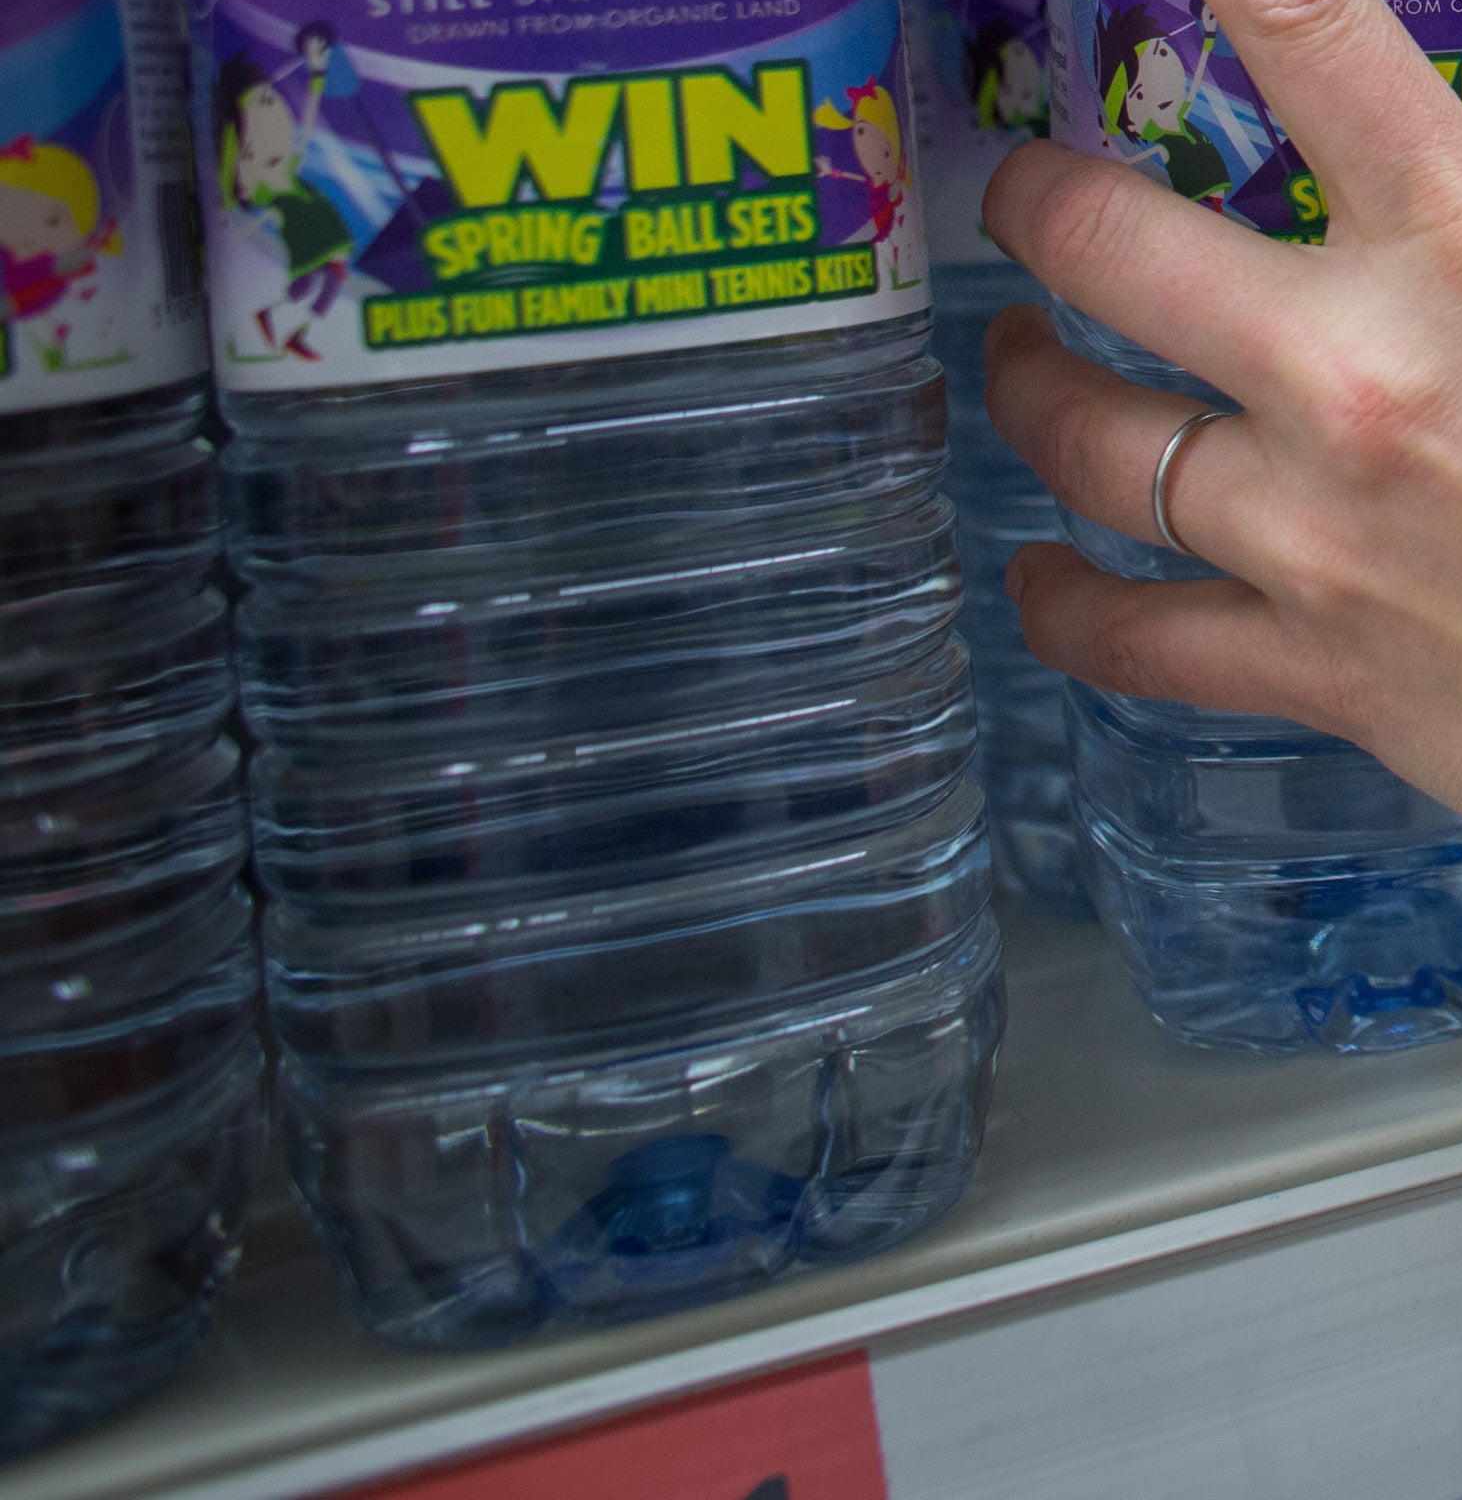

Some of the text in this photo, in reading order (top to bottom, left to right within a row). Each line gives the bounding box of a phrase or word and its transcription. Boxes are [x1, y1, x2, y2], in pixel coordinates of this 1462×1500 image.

[408, 66, 807, 210] WIN
[426, 194, 816, 280] SPRING BALL SETS
[370, 250, 876, 343] PLUS FUN FAMILY MINI TENNIS KITS!
